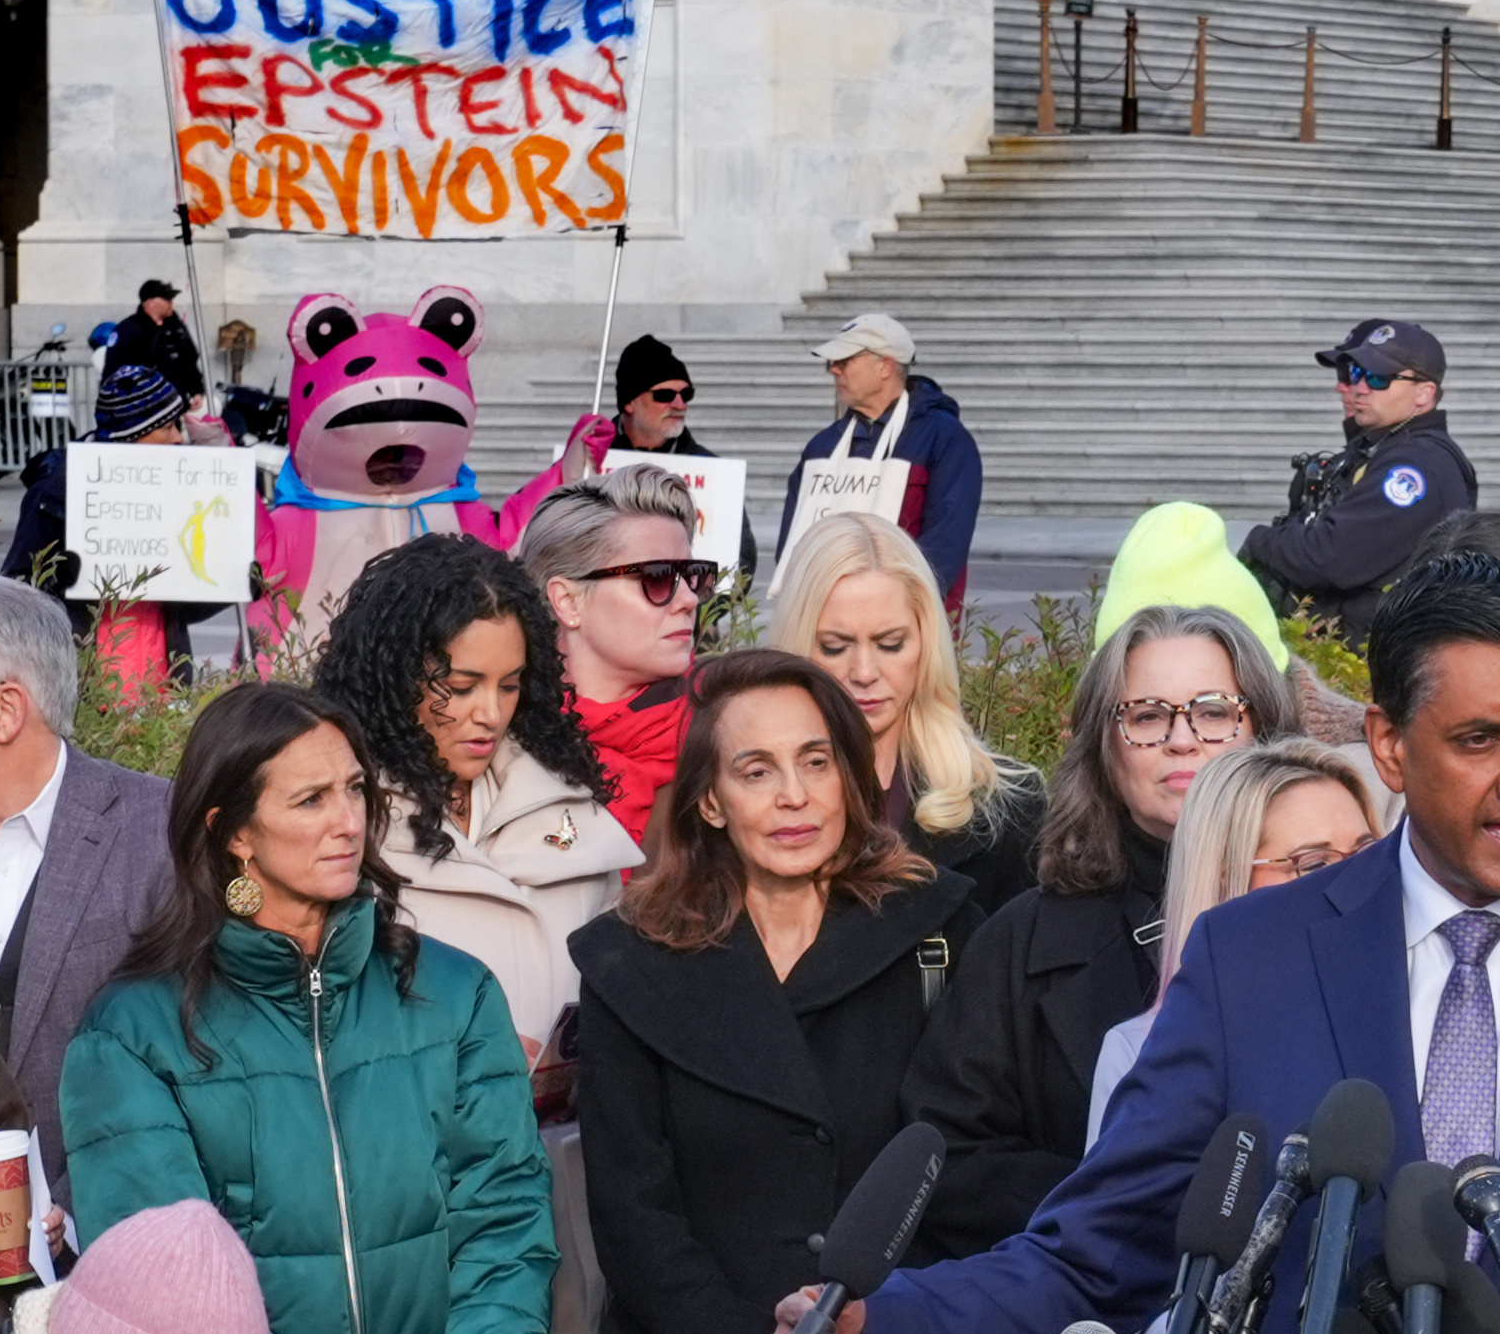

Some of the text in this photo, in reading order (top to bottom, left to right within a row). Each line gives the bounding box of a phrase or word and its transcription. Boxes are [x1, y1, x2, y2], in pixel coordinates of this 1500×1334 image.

[308, 38, 420, 72] FOR
[179, 45, 627, 140] EPSTEIN
[177, 125, 627, 240] SURVIVORS
[175, 457, 204, 486] for
[210, 459, 238, 487] the
[810, 473, 880, 496] TRUMP
[1220, 1150, 1249, 1218] SENNHEISER
[884, 1180, 930, 1261] SENNHEISER
